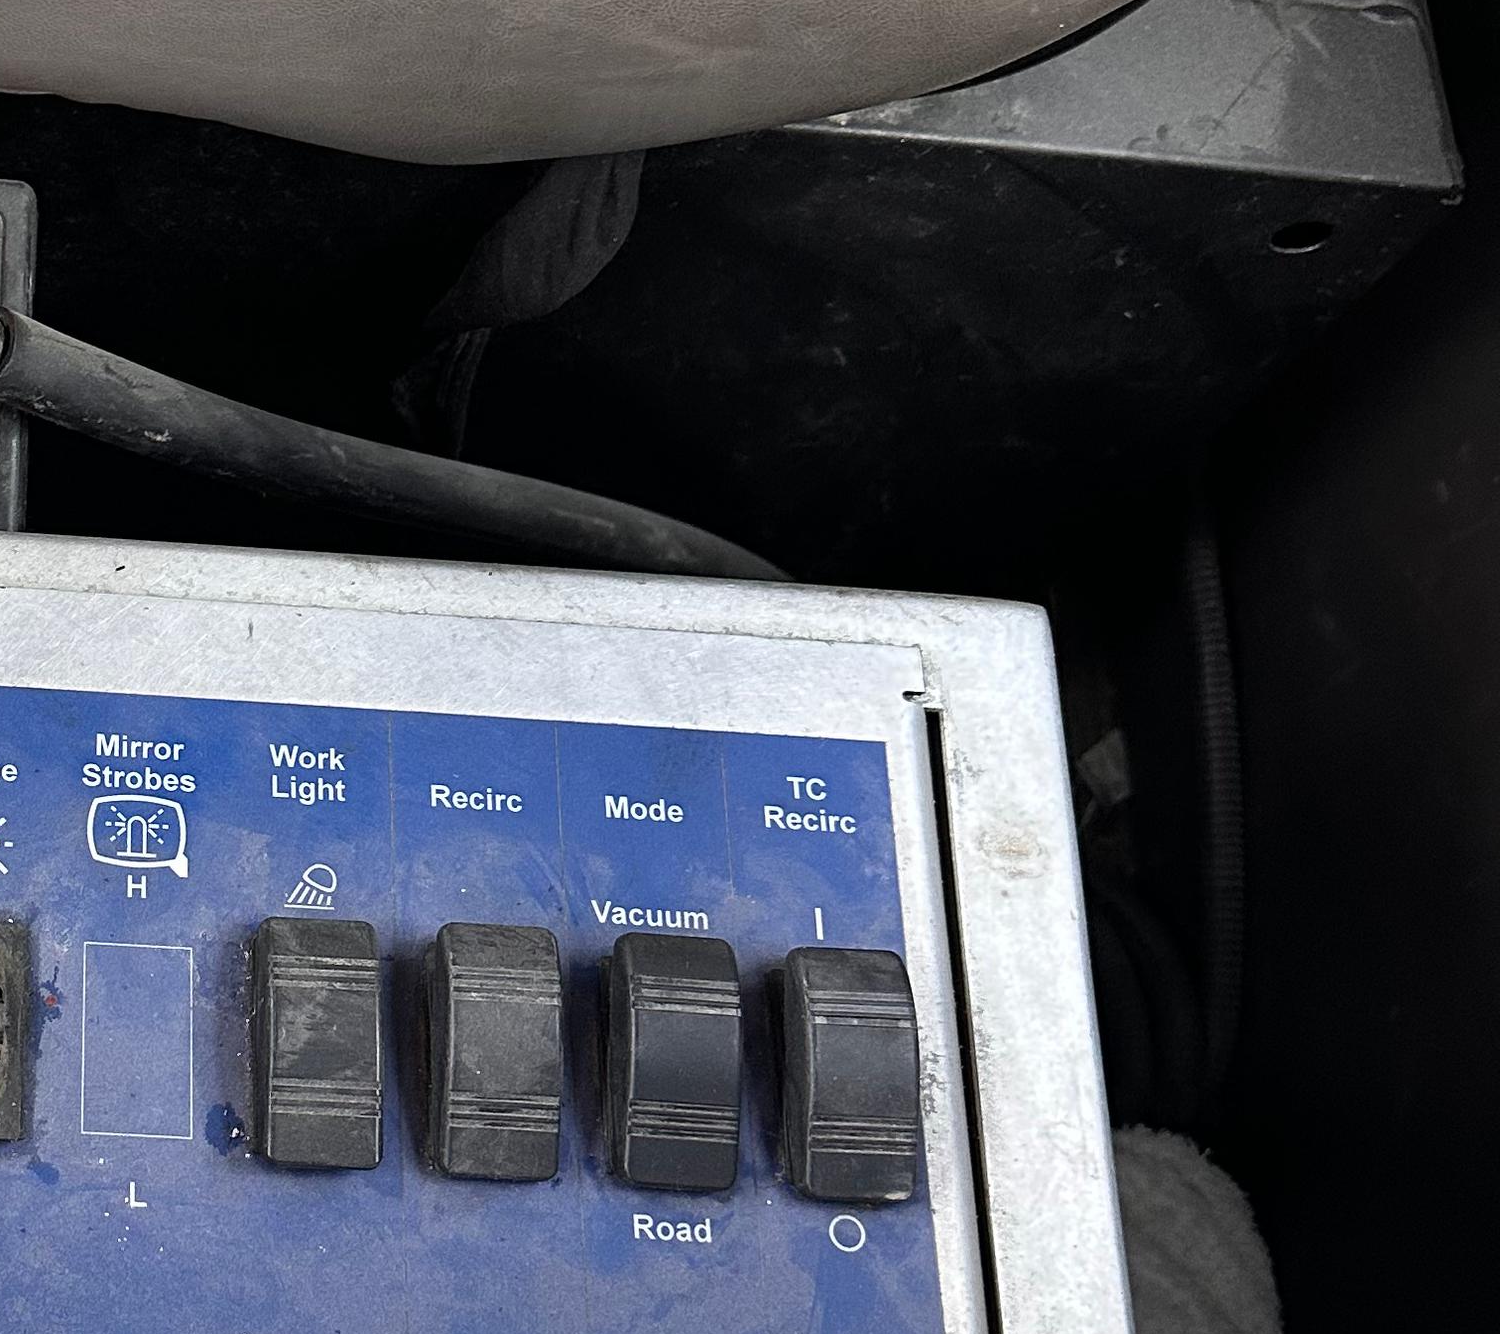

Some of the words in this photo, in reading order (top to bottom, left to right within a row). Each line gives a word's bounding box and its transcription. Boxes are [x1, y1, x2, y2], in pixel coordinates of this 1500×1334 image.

[95, 733, 185, 761] Mirror
[269, 743, 345, 771] Work
[81, 763, 196, 794] Strobes
[270, 774, 346, 806] Light
[786, 776, 827, 801] TC
[430, 784, 523, 813] Recirc
[604, 795, 684, 823] Mode
[763, 805, 857, 835] Recirc
[126, 874, 147, 899] H
[590, 899, 709, 930] Vacuum
[129, 1181, 148, 1209] L
[632, 1213, 713, 1244] Road
